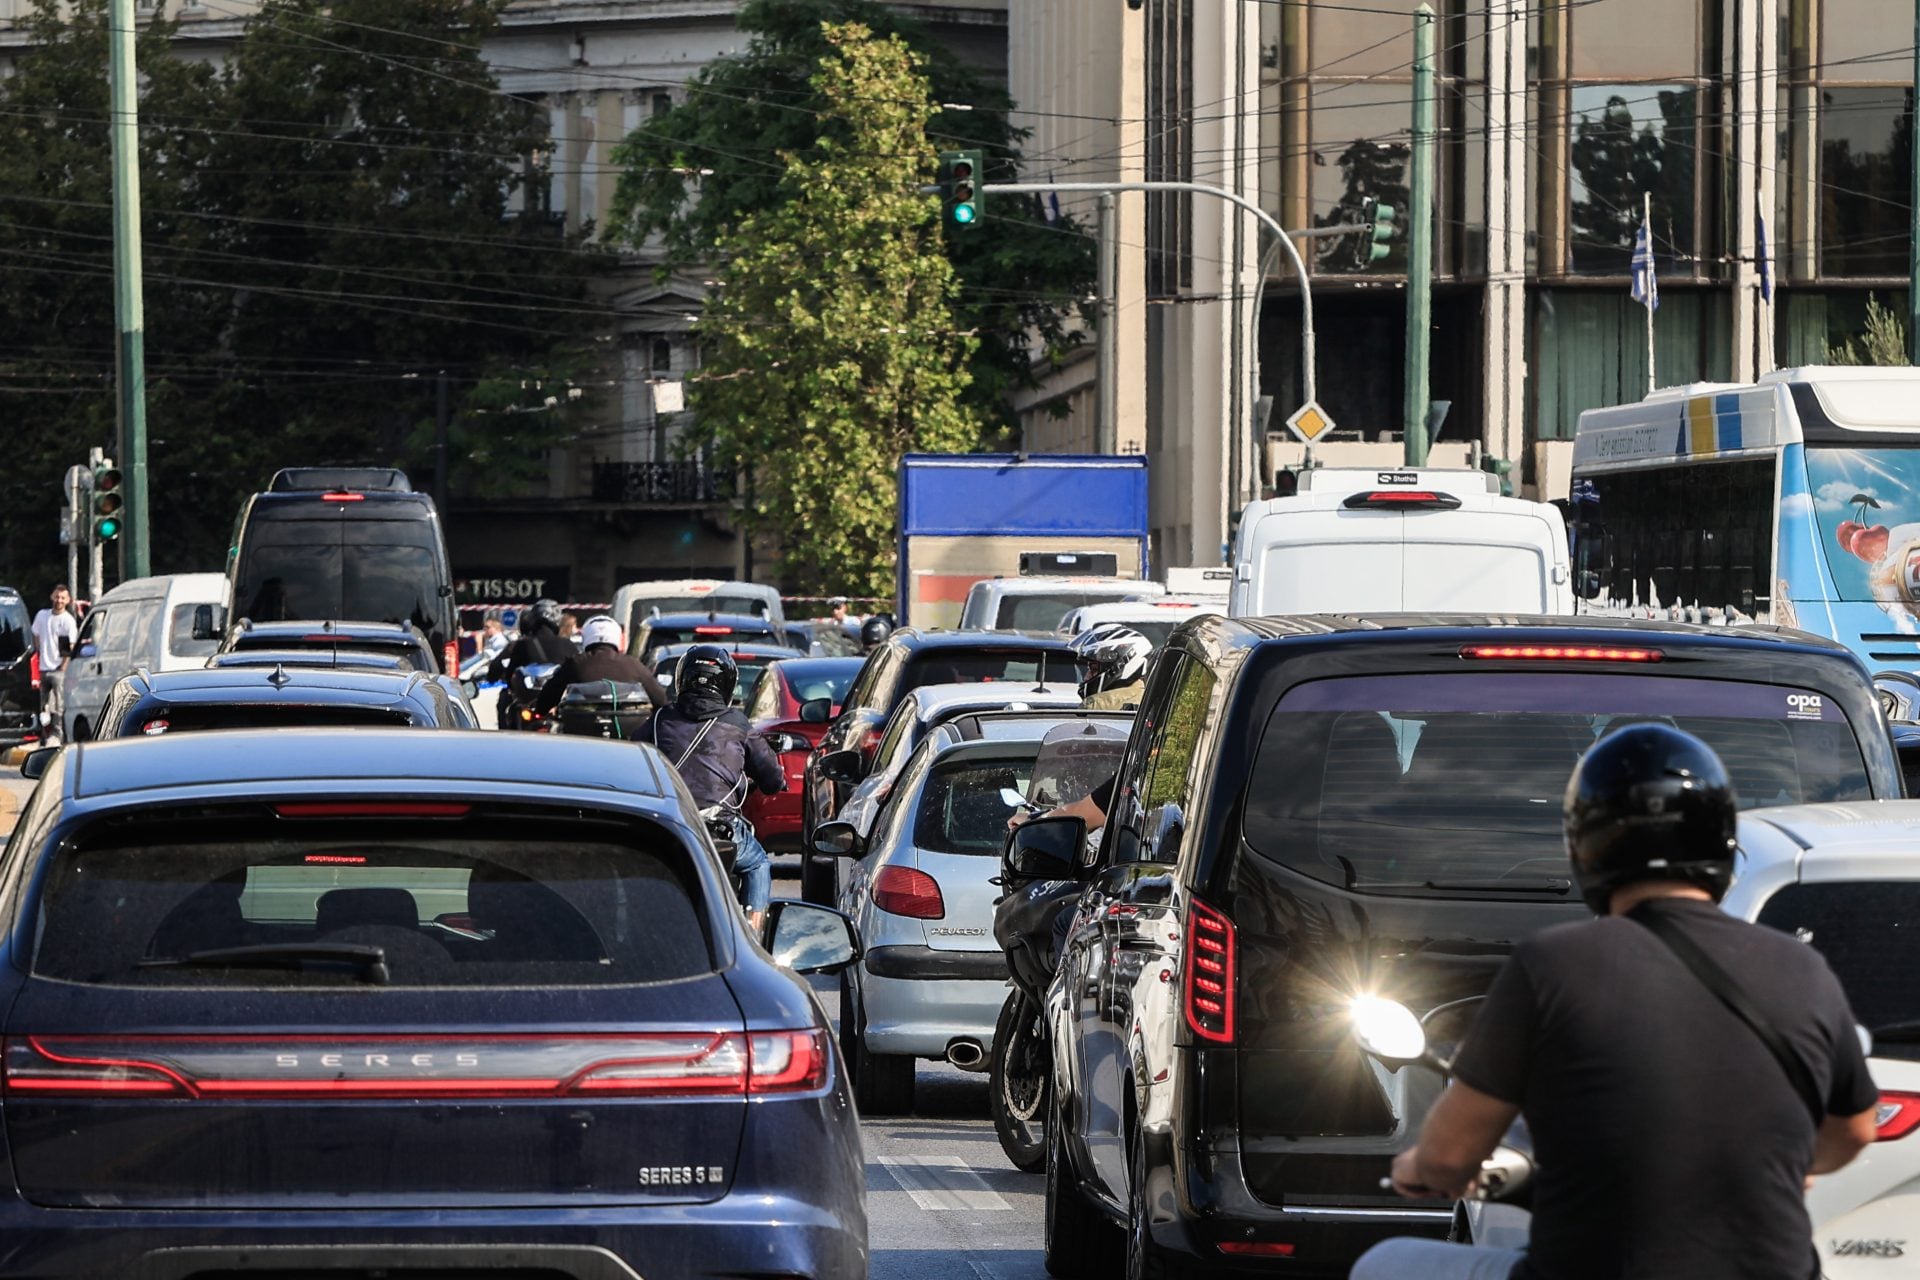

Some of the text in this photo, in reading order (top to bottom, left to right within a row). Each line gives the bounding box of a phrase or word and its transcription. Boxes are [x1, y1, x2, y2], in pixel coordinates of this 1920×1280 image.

[470, 579, 546, 598] TISSOT
[1786, 694, 1822, 712] opa
[931, 928, 988, 936] PEUGEOT
[276, 1054, 478, 1067] SERES
[639, 1167, 692, 1185] SERES
[695, 1166, 705, 1184] 5
